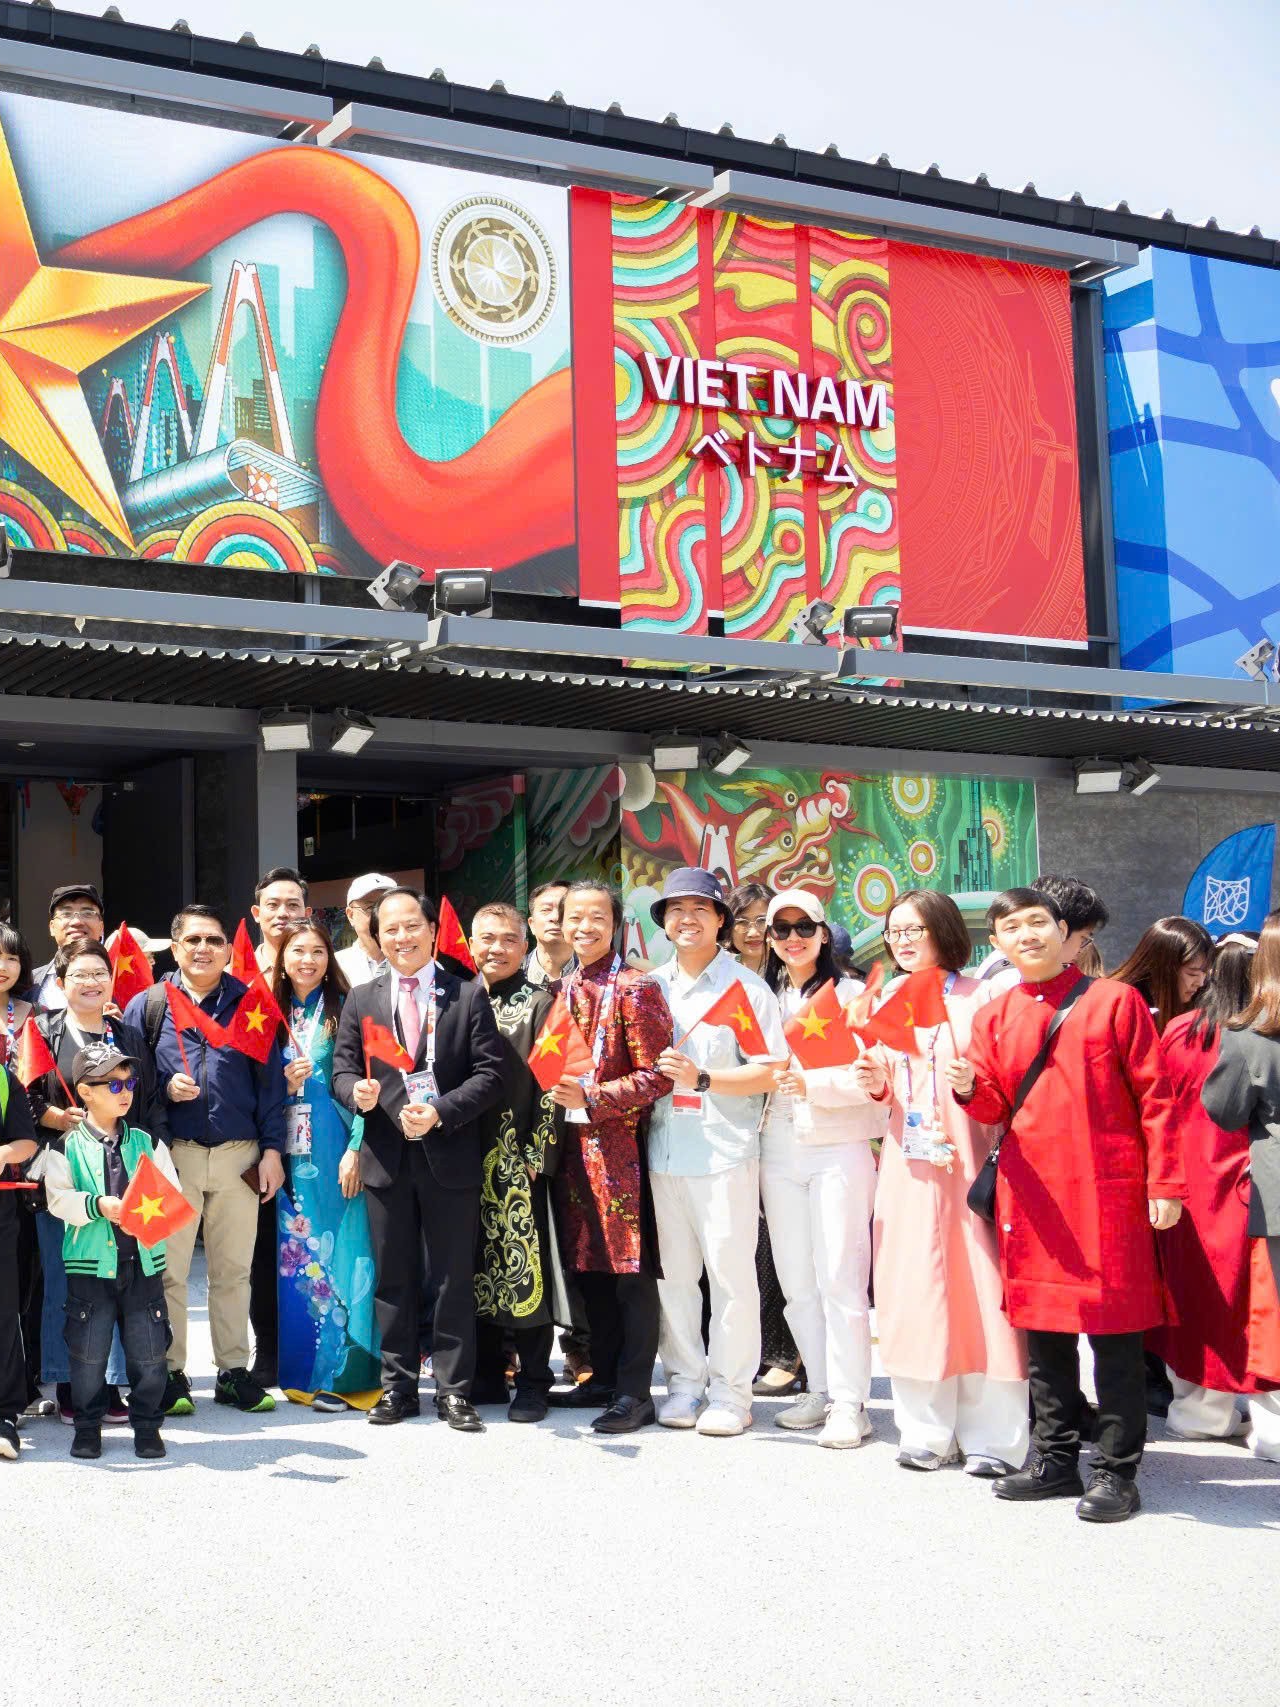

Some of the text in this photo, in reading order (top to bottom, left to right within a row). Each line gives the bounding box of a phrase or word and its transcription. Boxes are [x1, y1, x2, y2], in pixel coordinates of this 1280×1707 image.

[644, 352, 887, 427] VIET NAM
[692, 429, 859, 487] ベトナム
